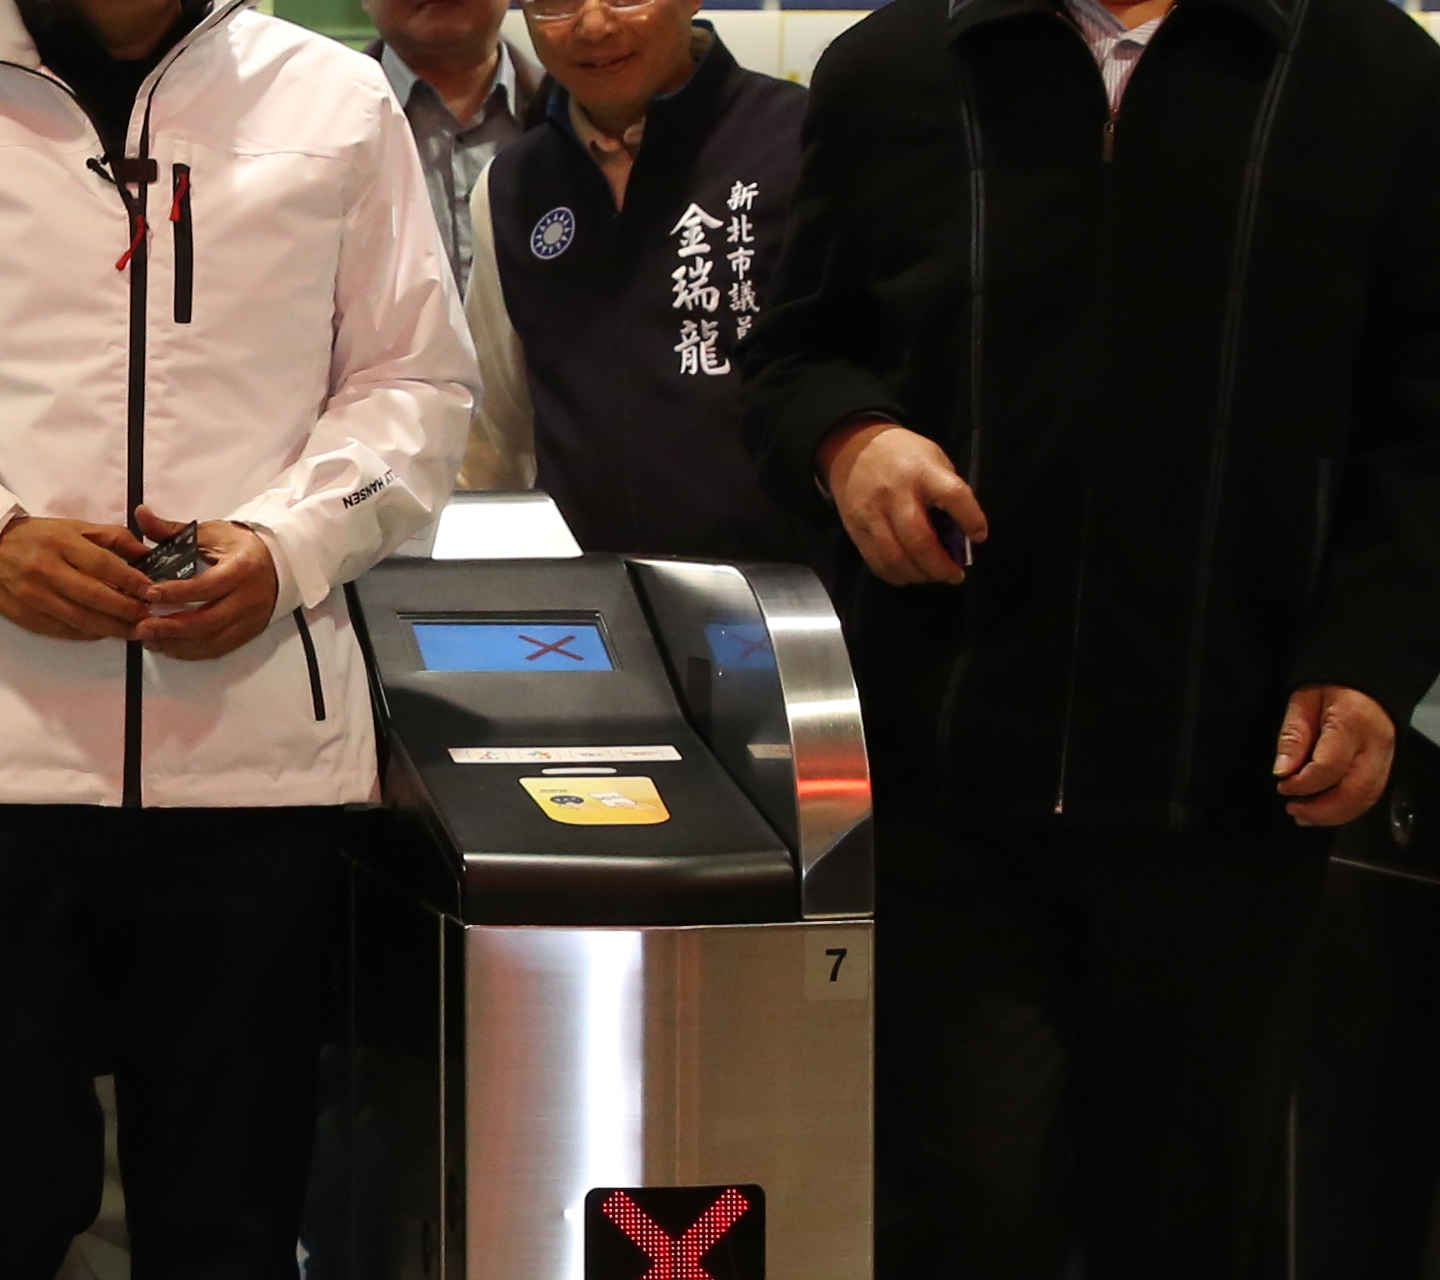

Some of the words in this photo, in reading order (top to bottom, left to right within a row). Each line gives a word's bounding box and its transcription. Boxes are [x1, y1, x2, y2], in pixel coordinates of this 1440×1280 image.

[670, 203, 731, 376] 金瑞龍
[342, 476, 386, 509] HANSEN
[825, 948, 848, 982] 7
